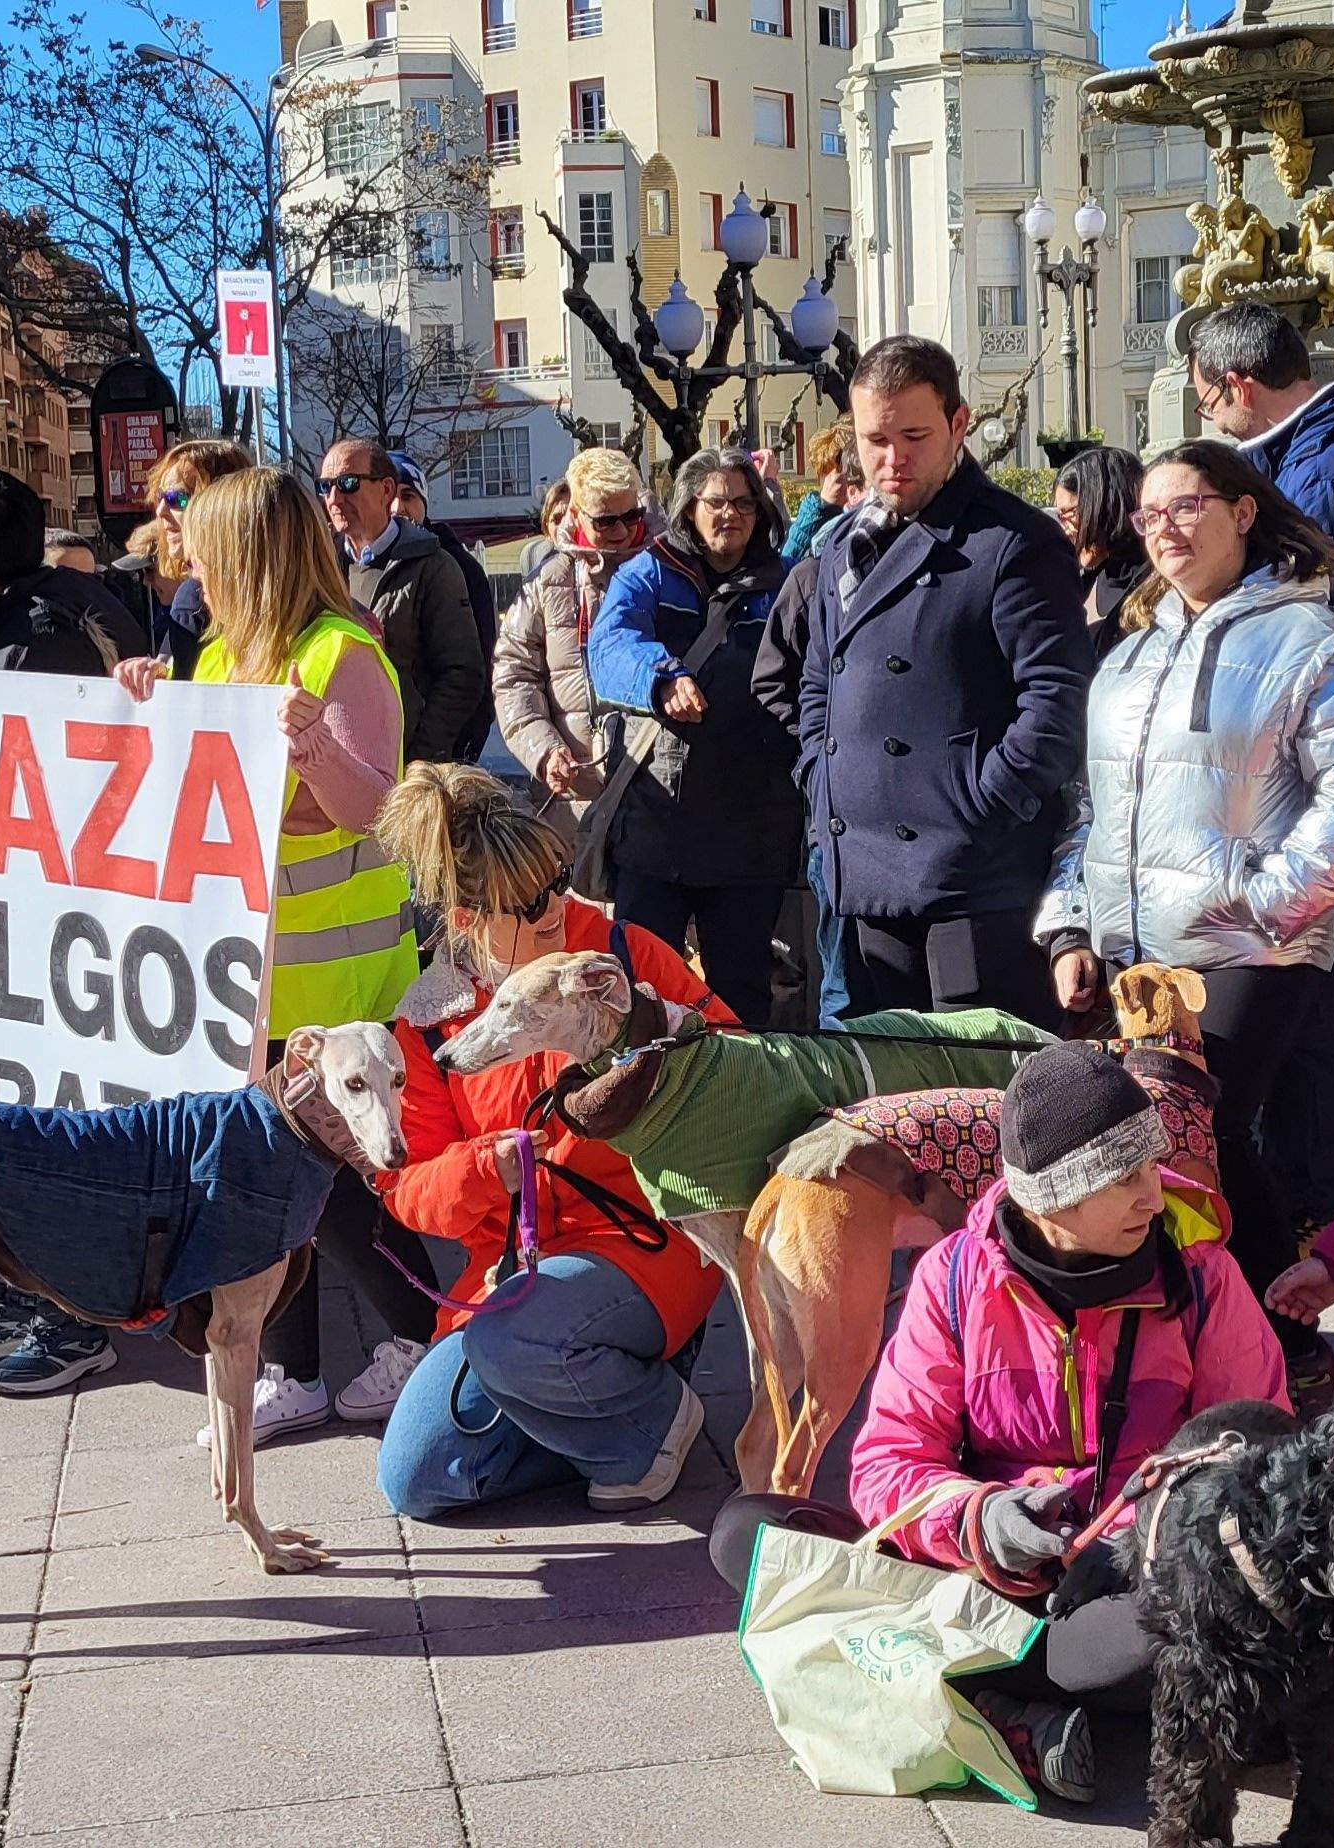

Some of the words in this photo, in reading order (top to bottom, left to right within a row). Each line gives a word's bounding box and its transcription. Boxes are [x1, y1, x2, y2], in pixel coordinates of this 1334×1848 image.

[127, 416, 140, 427] UNA
[141, 415, 159, 426] HORA
[128, 427, 150, 438] MENOS
[128, 438, 145, 449] PARA
[847, 1637, 892, 1683] GREEN
